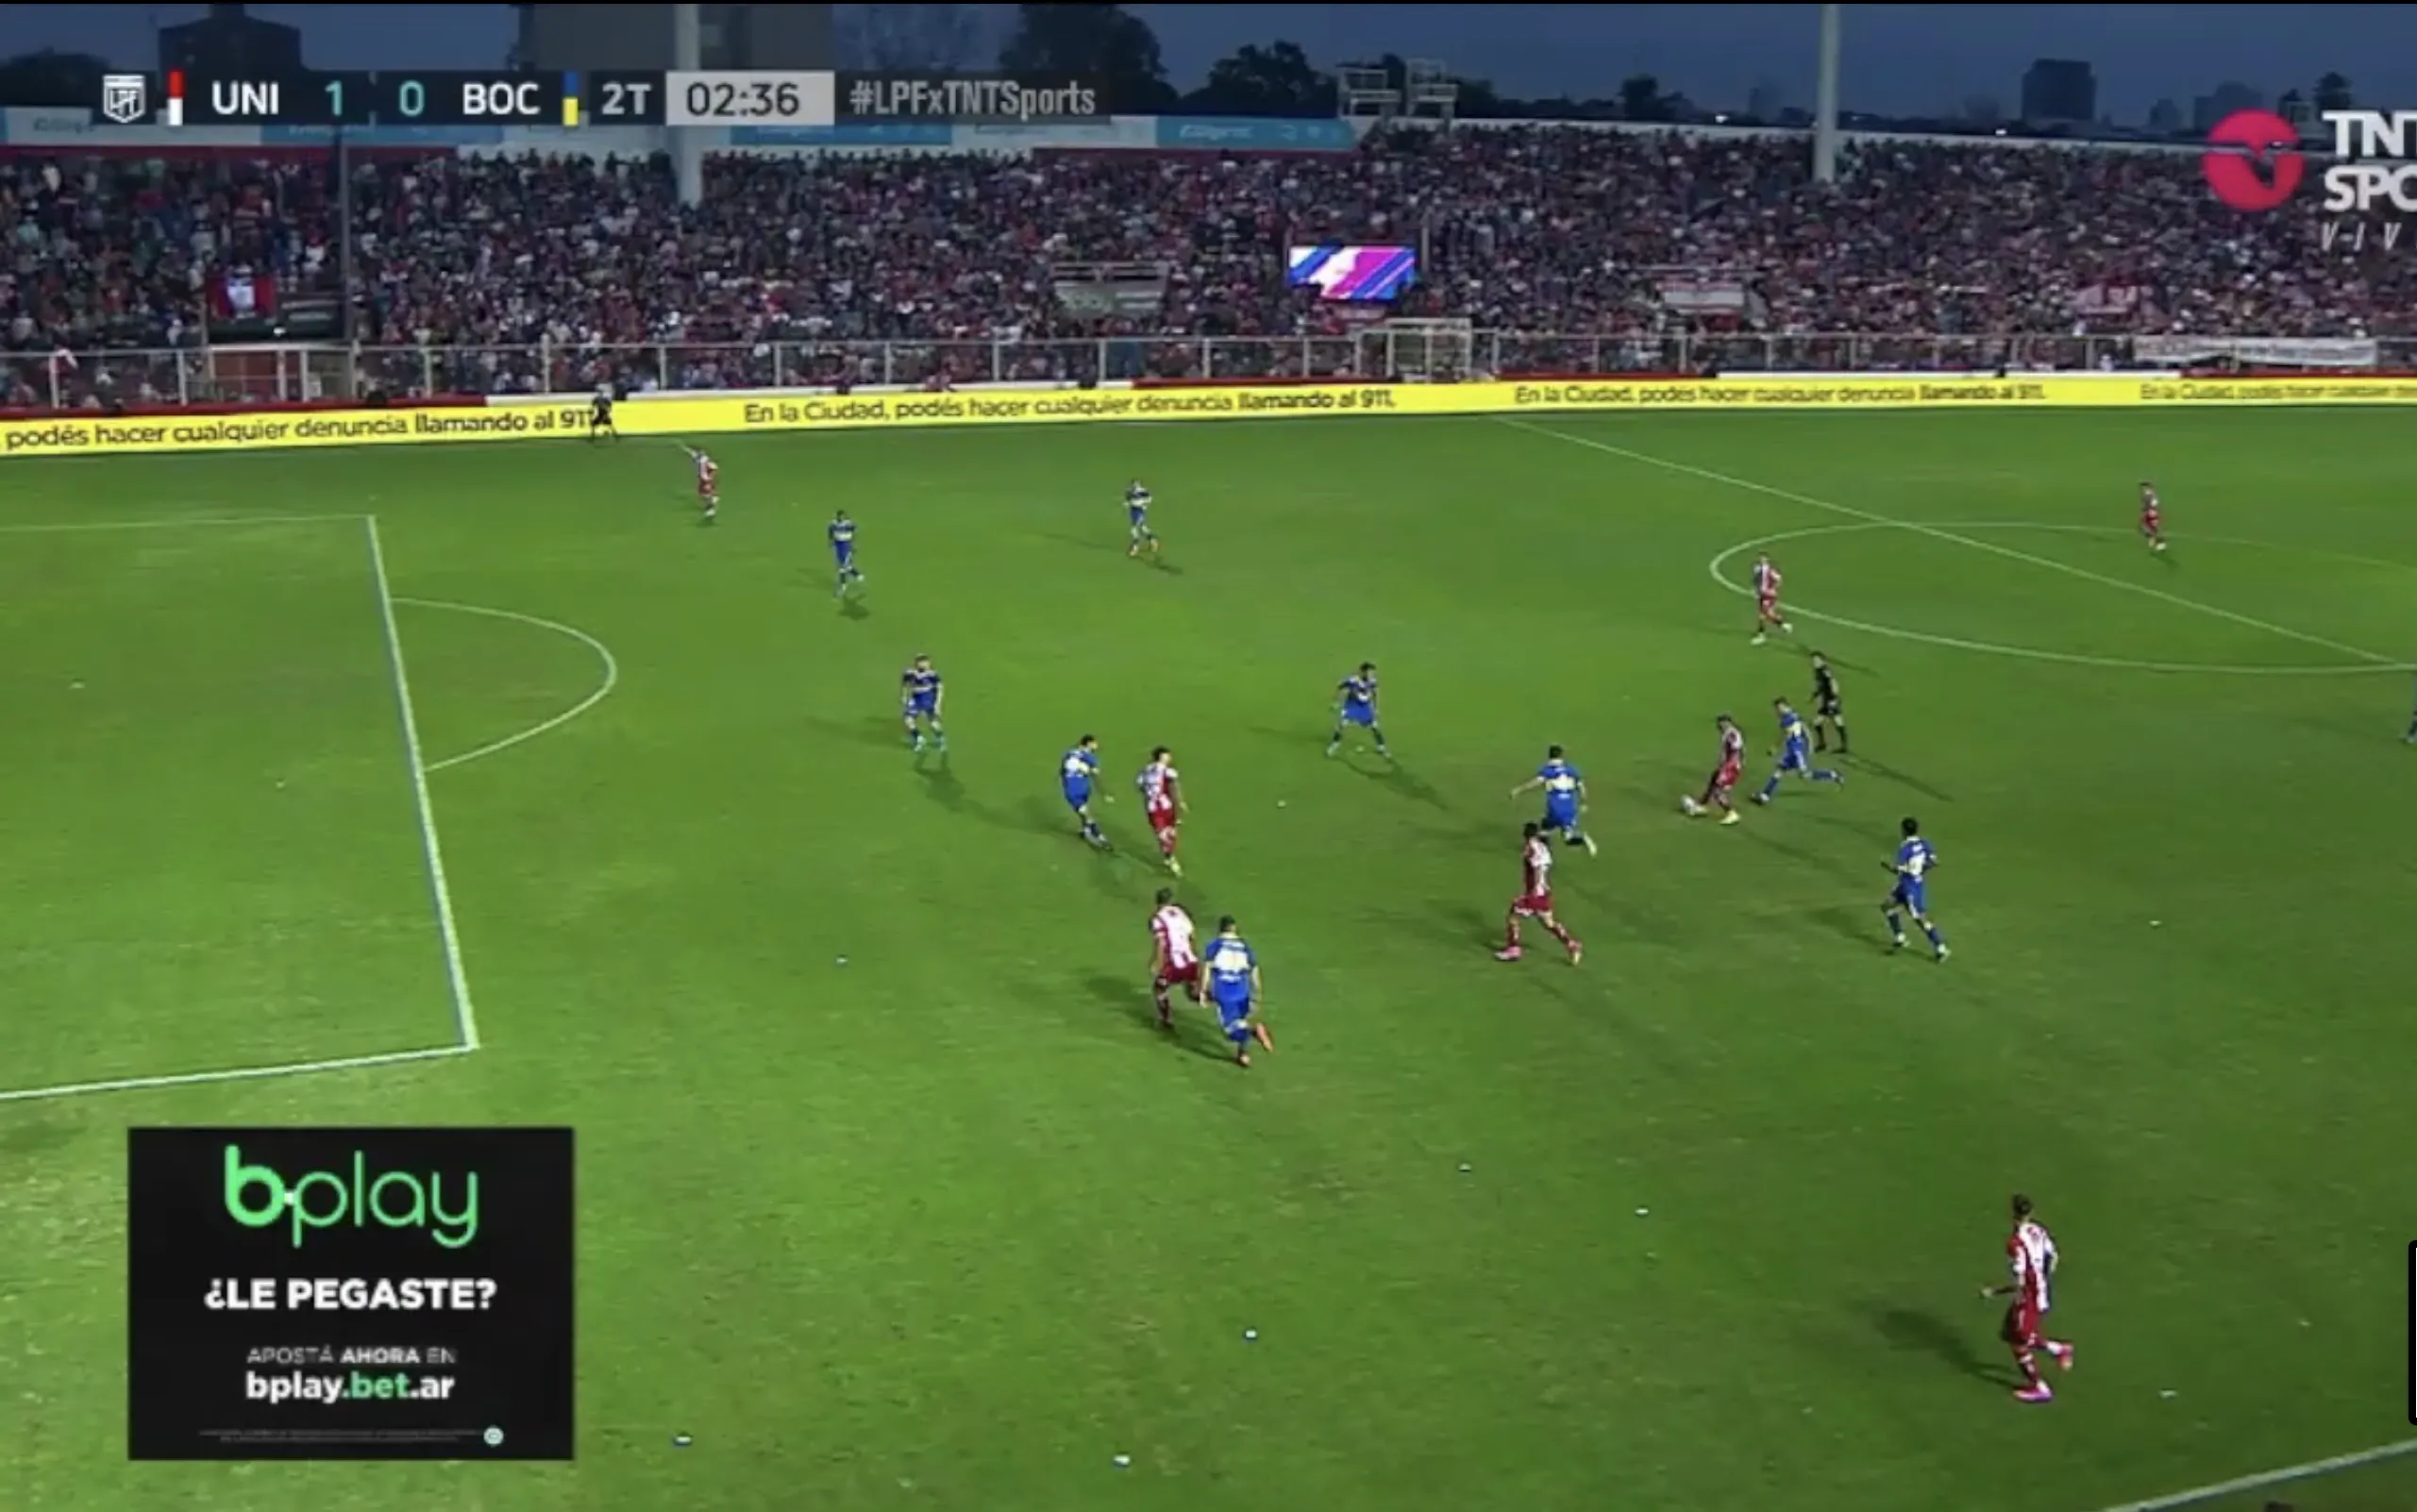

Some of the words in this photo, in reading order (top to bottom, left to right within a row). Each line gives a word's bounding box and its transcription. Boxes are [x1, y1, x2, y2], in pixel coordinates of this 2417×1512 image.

[744, 404, 774, 423] En
[779, 403, 799, 421] la
[804, 400, 890, 421] Ciudad,
[896, 399, 964, 420] podés
[969, 397, 1028, 416] hacer
[1033, 394, 1132, 416] cualquier
[1136, 393, 1233, 412] denuncia
[1238, 390, 1334, 410] llamando
[1337, 390, 1356, 409] al
[6, 424, 89, 450] podés
[94, 423, 167, 445] hacer
[173, 420, 288, 443] cualquier
[294, 415, 407, 438] denuncia
[415, 412, 527, 433] llamando
[533, 409, 555, 431] al
